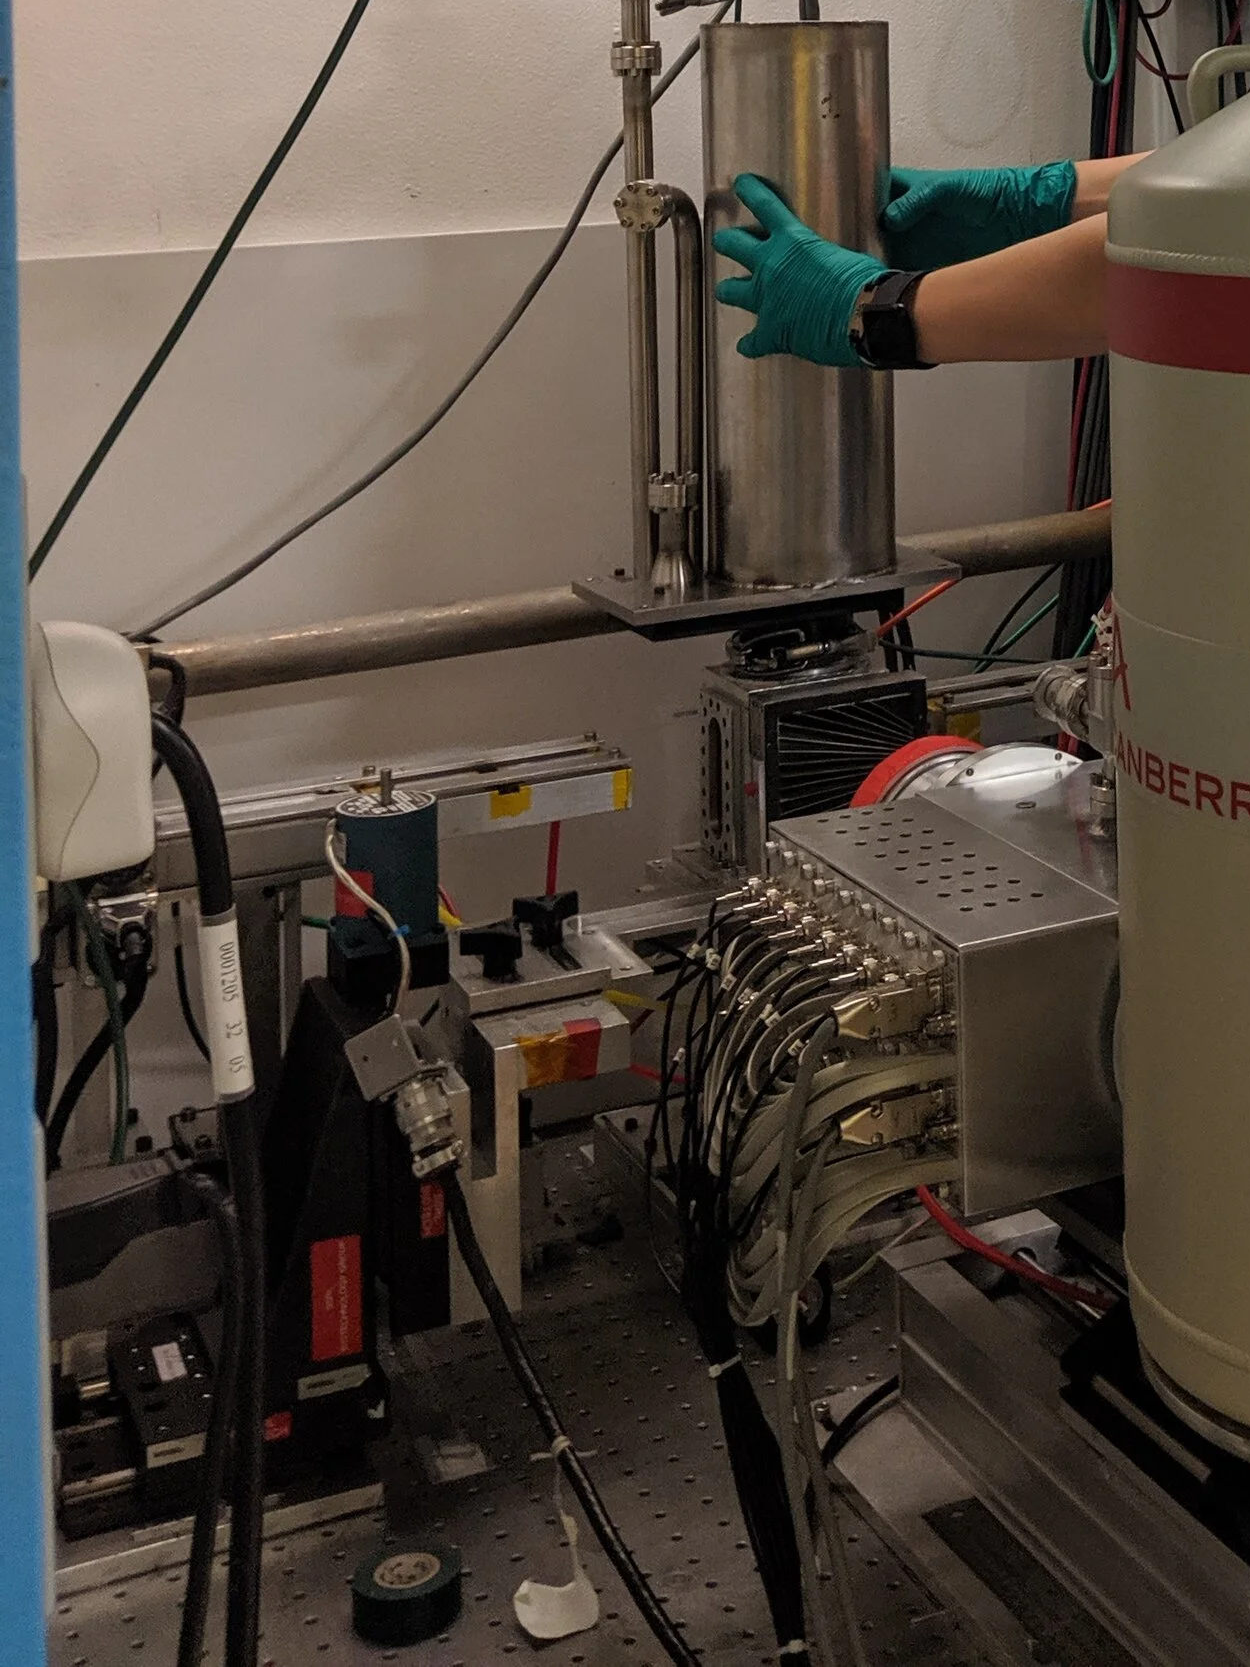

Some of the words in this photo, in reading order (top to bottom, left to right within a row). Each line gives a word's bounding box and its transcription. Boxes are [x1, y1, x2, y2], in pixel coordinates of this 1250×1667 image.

[219, 941, 239, 1003] 0001205
[226, 1021, 243, 1039] 32
[229, 1055, 245, 1074] 05
